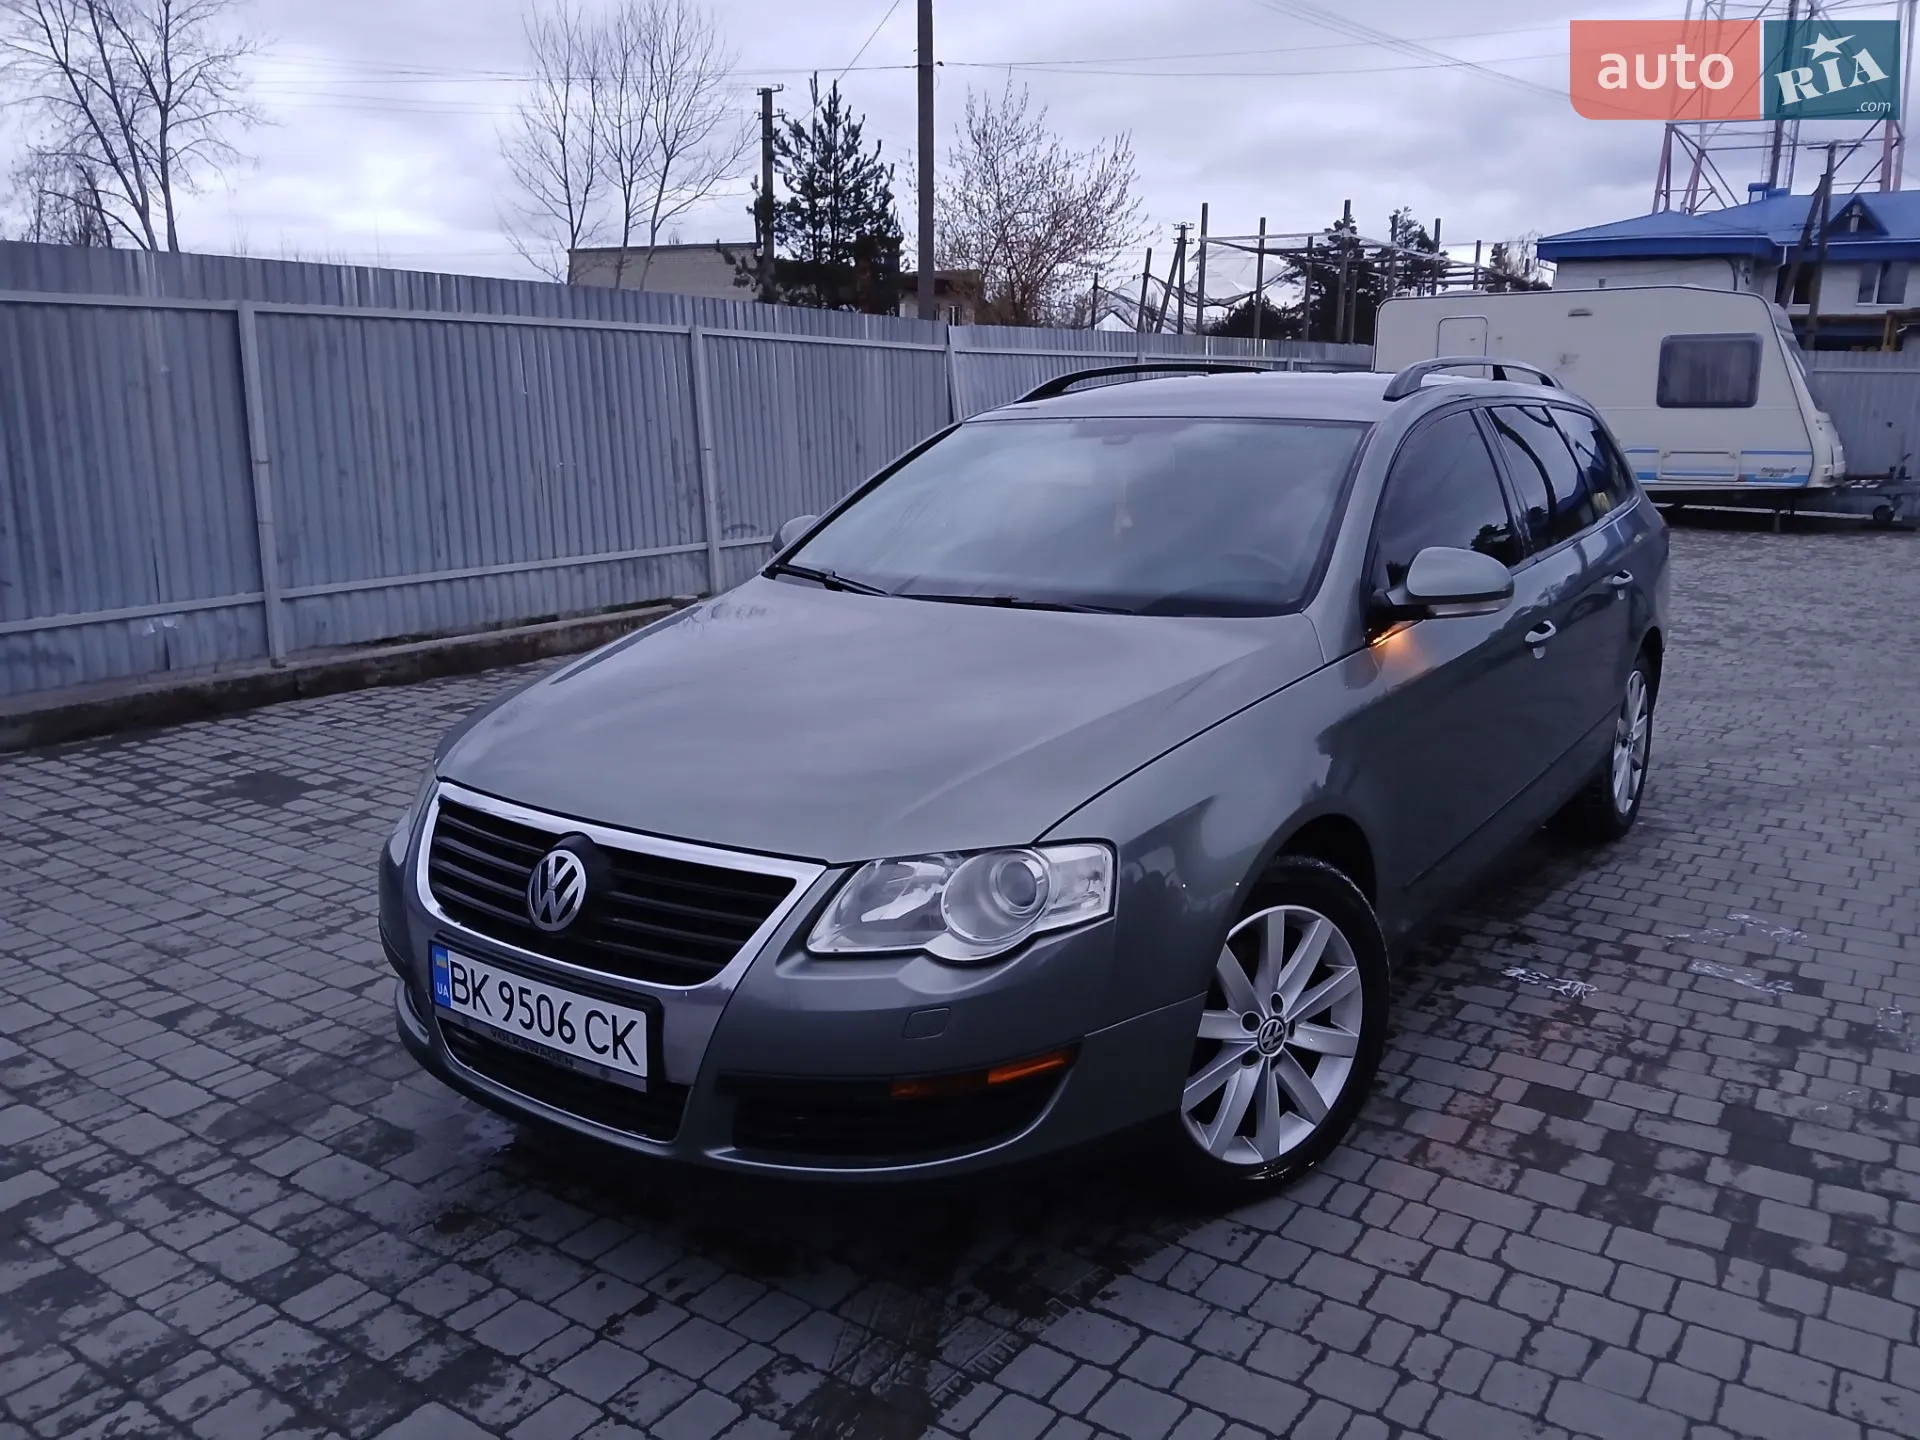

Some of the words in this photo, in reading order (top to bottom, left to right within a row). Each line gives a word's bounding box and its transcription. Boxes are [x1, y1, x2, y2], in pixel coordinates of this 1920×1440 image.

[436, 981, 449, 998] UA
[450, 960, 493, 1017] BK
[498, 981, 576, 1045] 9506
[585, 1009, 639, 1067] CK
